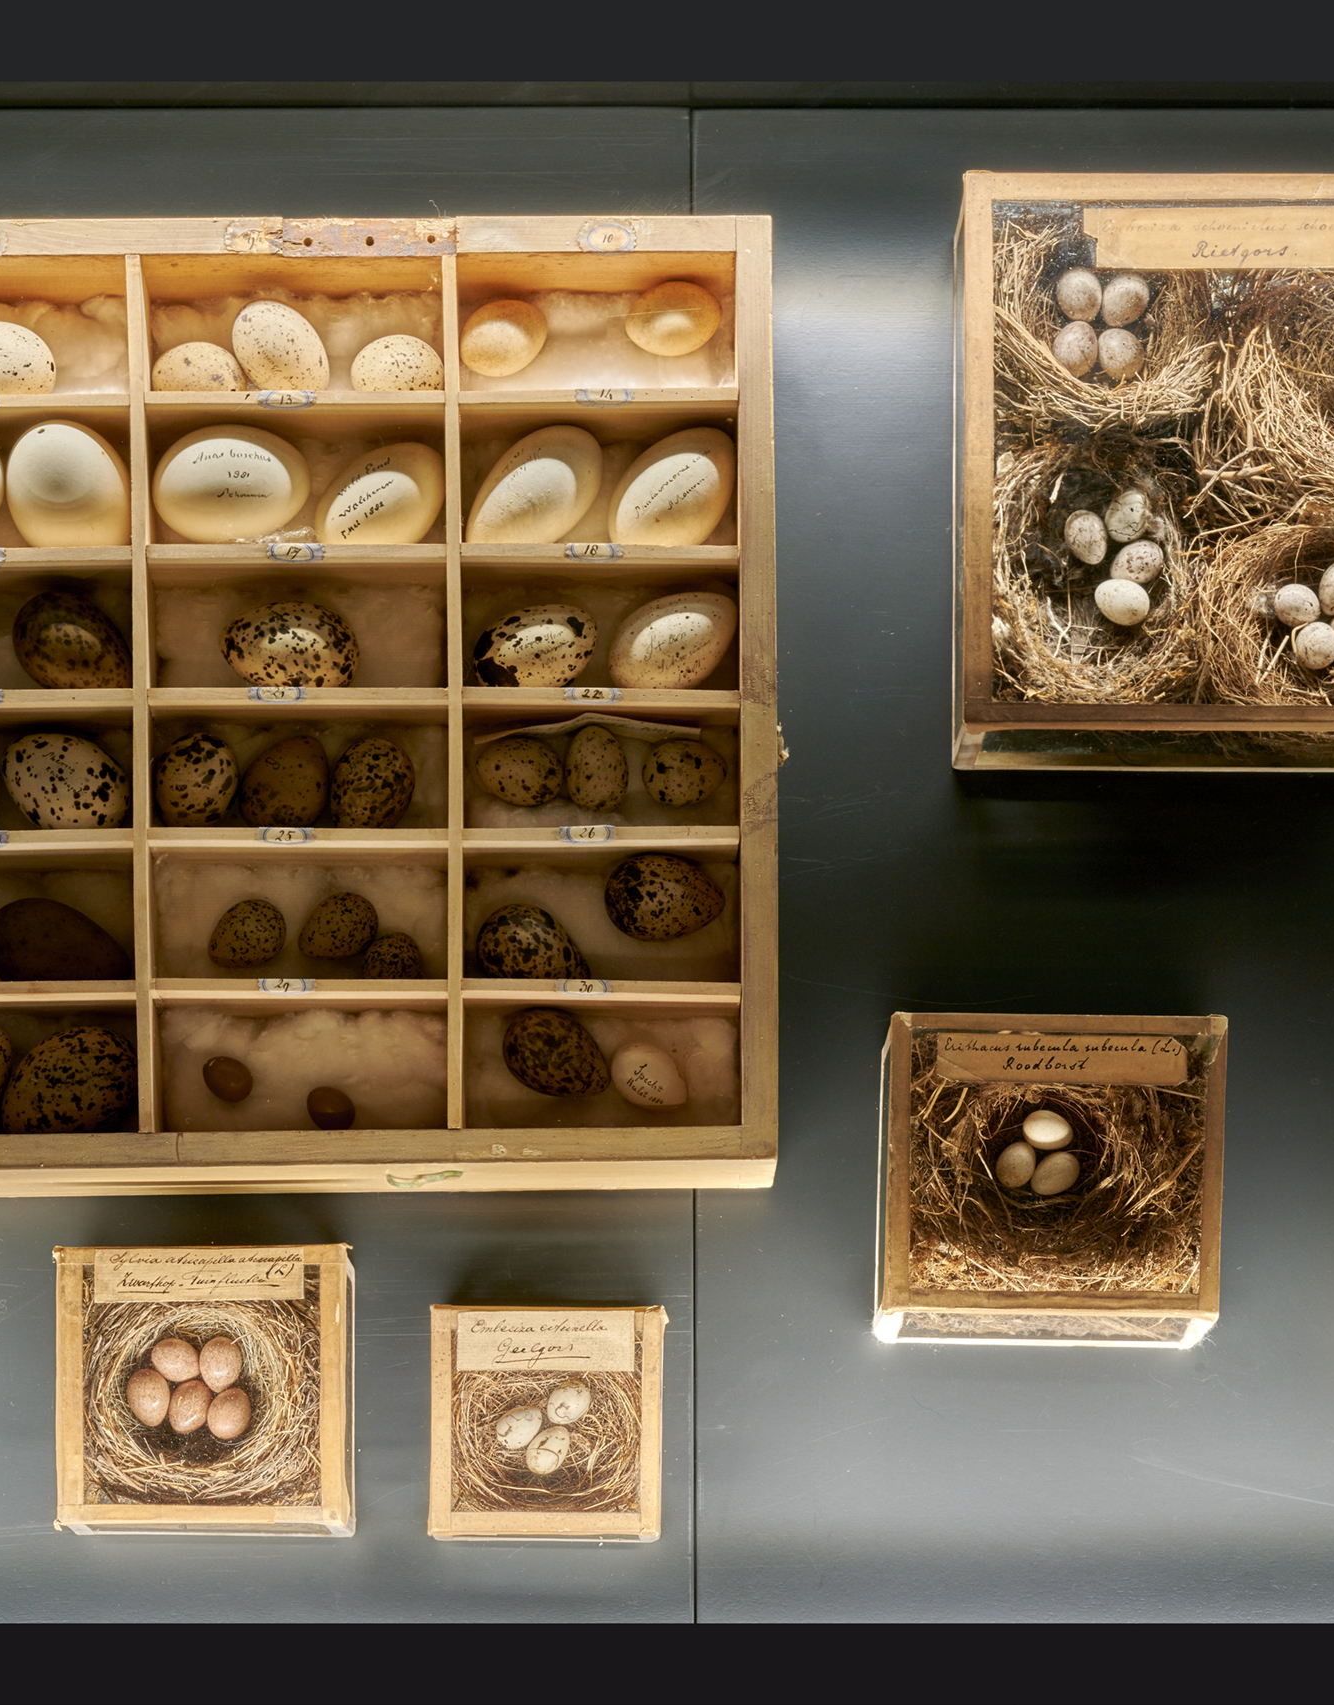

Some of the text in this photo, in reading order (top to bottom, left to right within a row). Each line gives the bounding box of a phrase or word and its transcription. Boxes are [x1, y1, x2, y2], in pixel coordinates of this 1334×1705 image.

[583, 544, 599, 557] 18
[275, 829, 296, 842] 25
[579, 827, 596, 840] 26
[578, 979, 594, 994] 30
